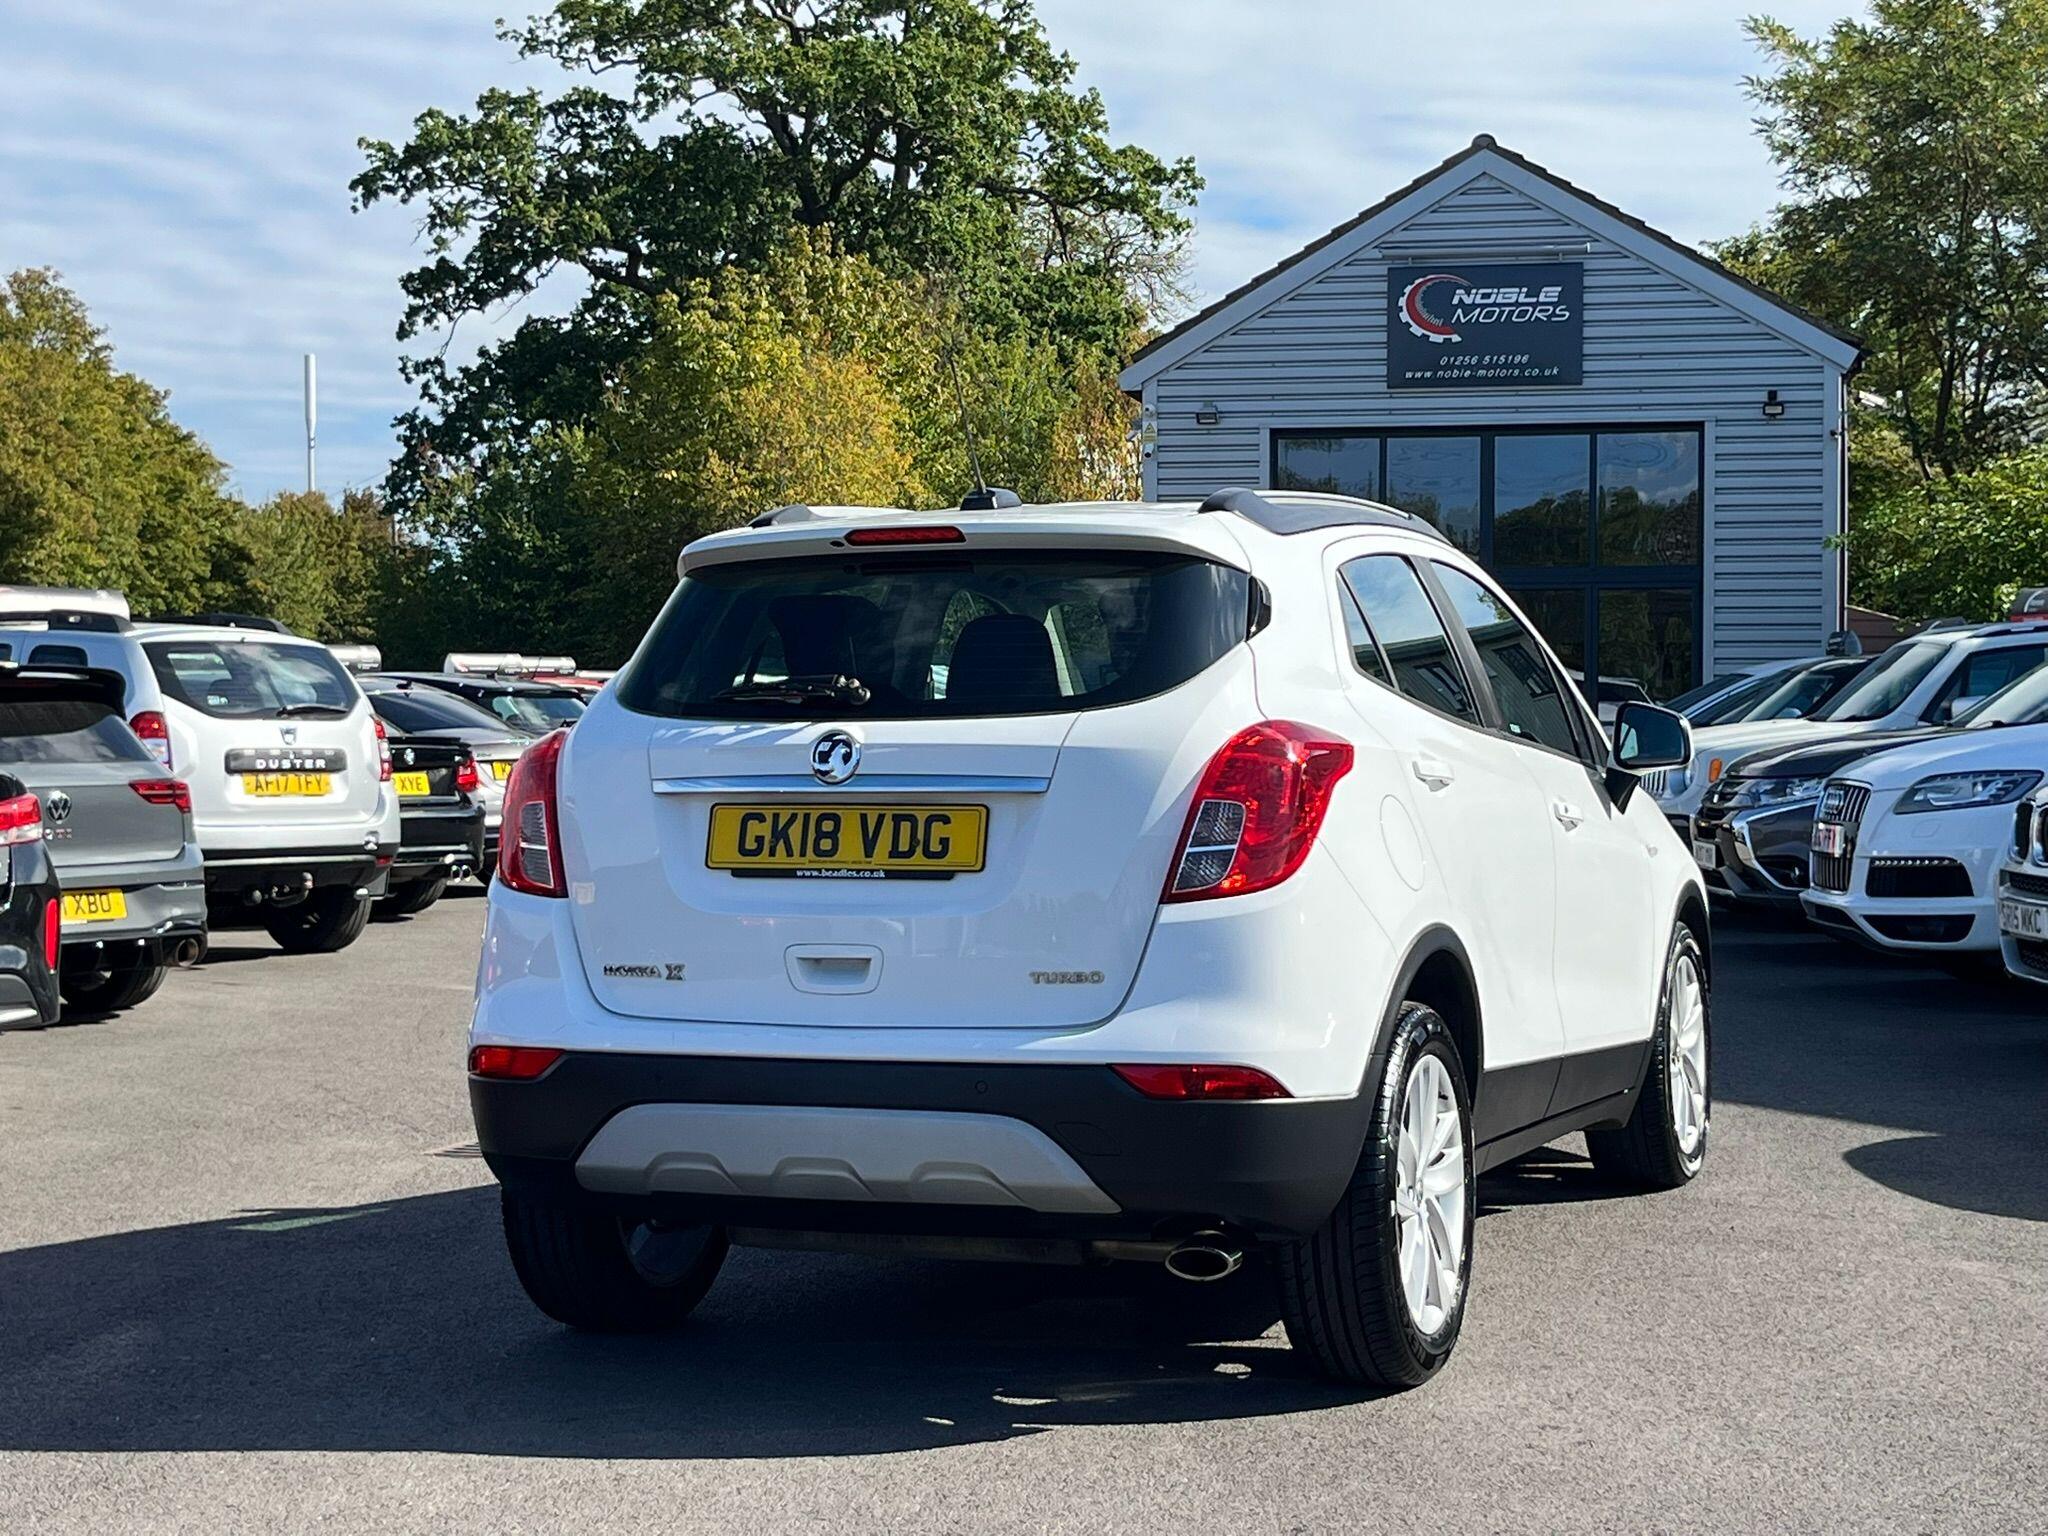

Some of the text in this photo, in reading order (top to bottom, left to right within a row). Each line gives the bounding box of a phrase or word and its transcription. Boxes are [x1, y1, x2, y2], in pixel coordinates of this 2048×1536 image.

[1452, 286, 1563, 305] NOBLE
[1451, 305, 1570, 324] MOTORS
[1439, 355, 1479, 366] 01256
[255, 758, 327, 770] DUSTER
[399, 775, 424, 792] XYE
[737, 811, 952, 860] GK18 VDG
[1028, 970, 1105, 985] TURBO
